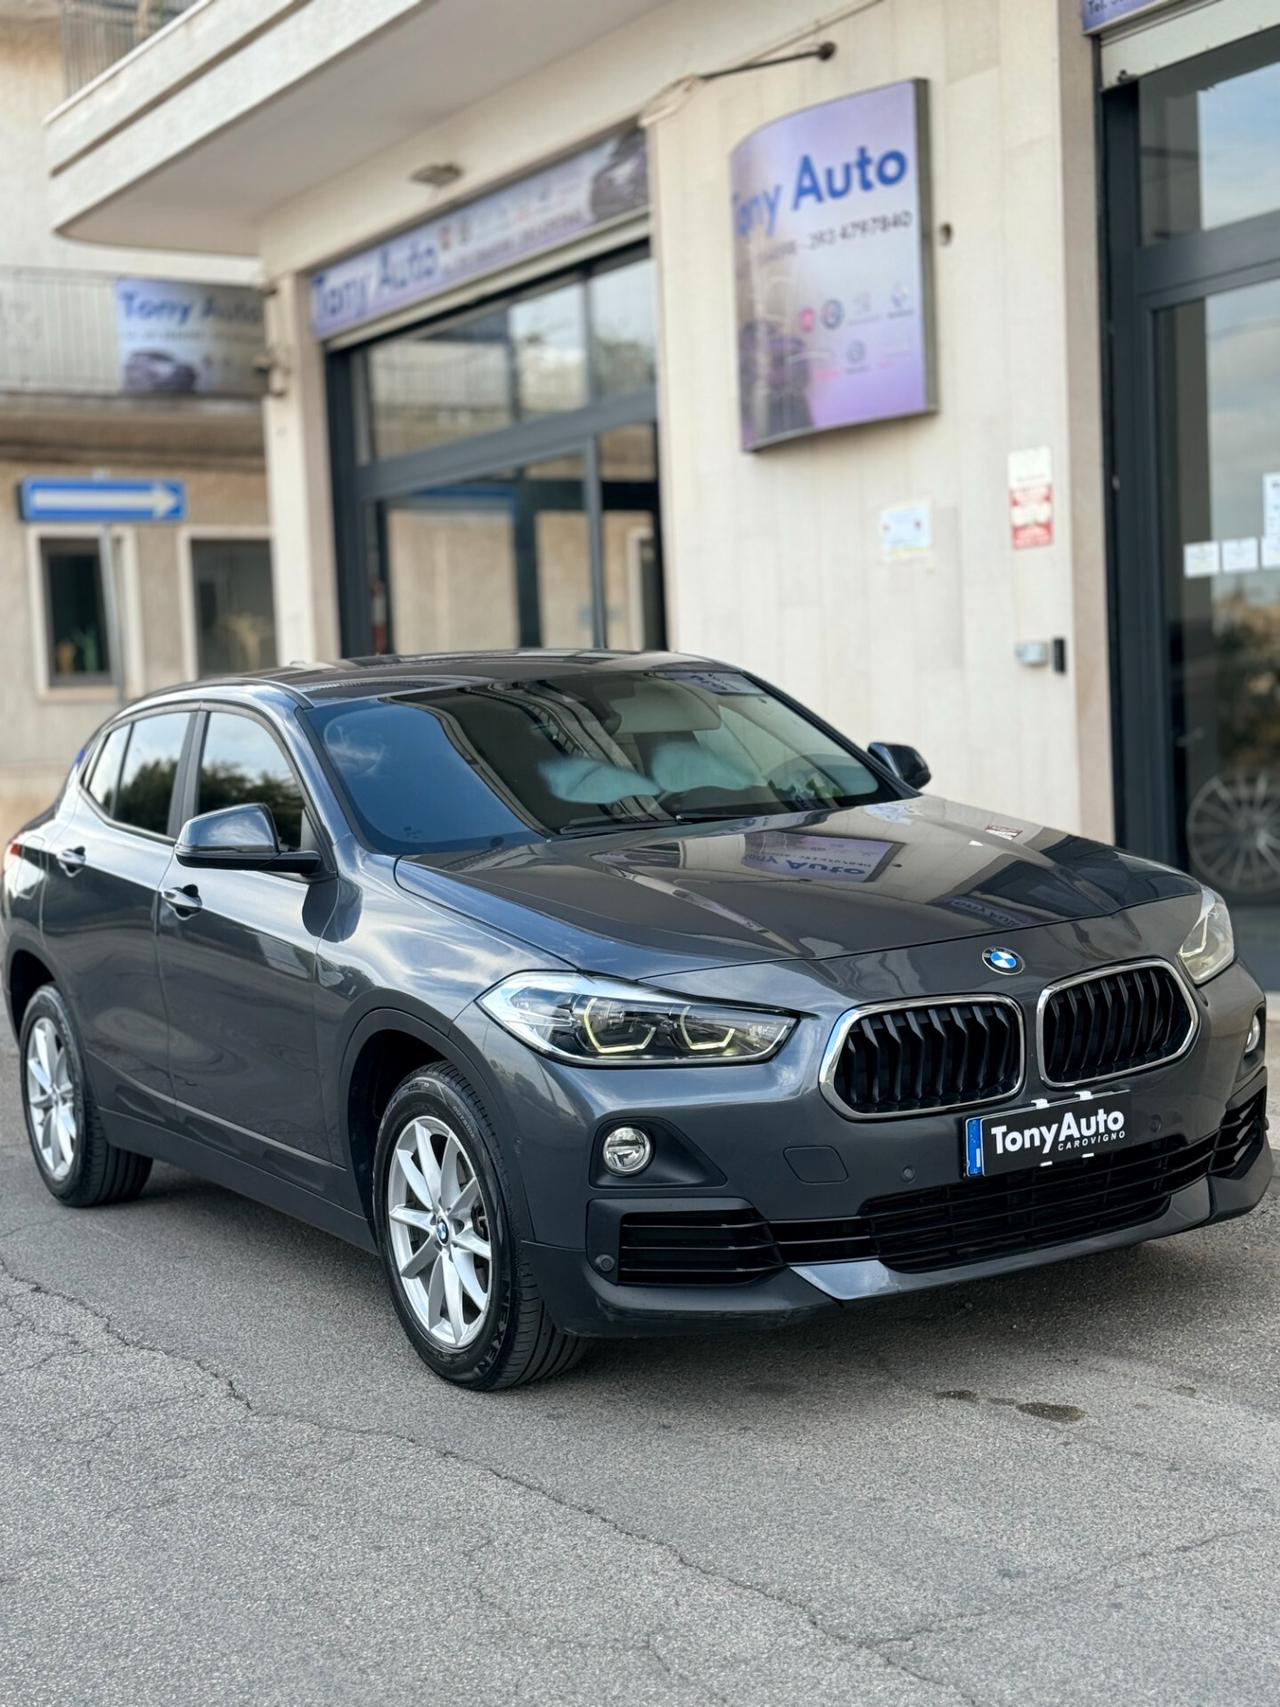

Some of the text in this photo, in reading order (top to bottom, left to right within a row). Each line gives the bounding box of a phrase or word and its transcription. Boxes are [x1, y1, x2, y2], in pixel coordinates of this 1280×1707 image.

[791, 145, 907, 211] Auto
[311, 272, 371, 318] Tony
[375, 243, 439, 290] Auto
[122, 291, 193, 326] Tony
[991, 1108, 1125, 1154] TonyAuto
[1058, 1130, 1126, 1151] CAROVIGNO
